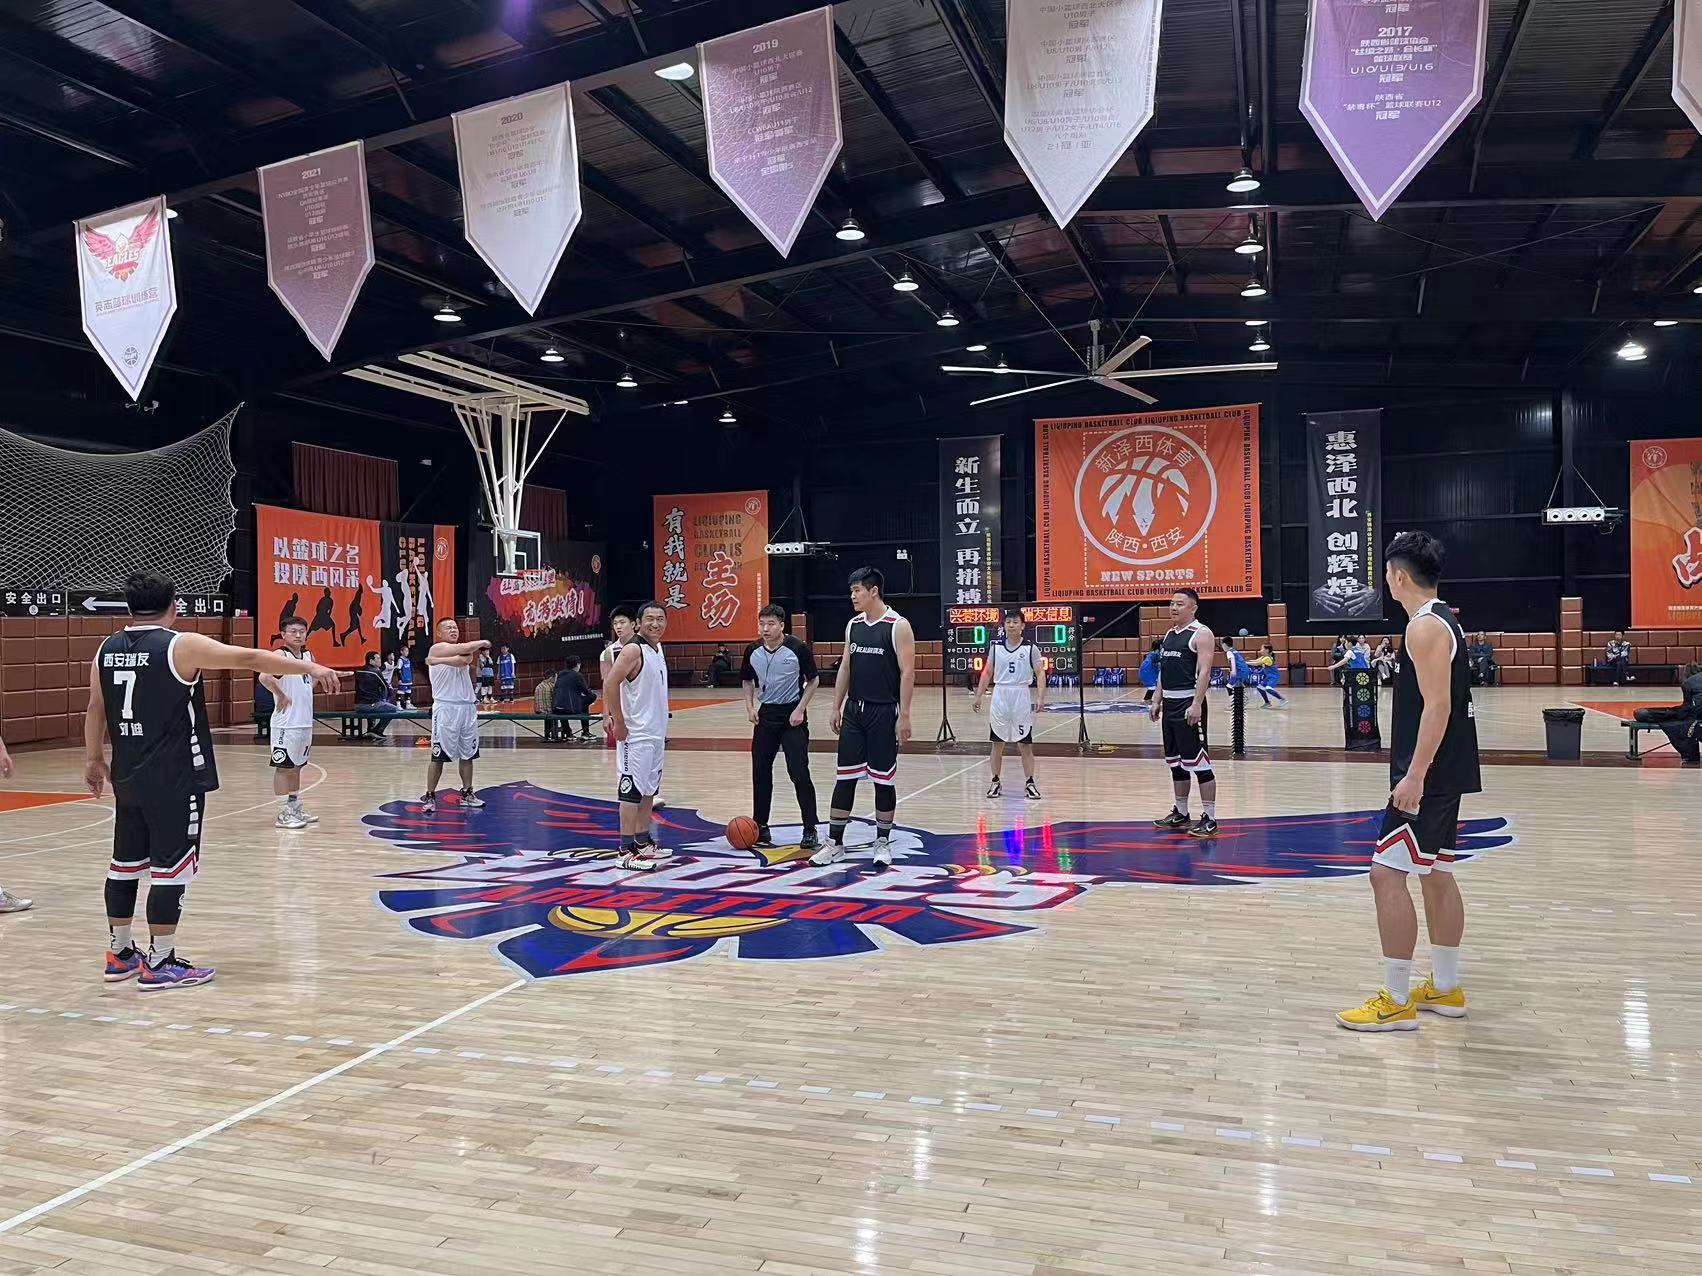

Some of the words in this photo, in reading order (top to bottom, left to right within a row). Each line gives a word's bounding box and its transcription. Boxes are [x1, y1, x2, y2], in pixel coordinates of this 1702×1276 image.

[1378, 26, 1412, 37] 2017
[752, 39, 779, 53] 2019
[1378, 73, 1404, 83] 冠军
[500, 112, 524, 126] 2020
[1376, 110, 1400, 120] 冠军
[301, 168, 321, 180] 2021
[1084, 418, 1124, 428] BASKETBALL
[1125, 416, 1143, 426] CLUB
[1180, 412, 1222, 422] BASKETBALL
[1223, 409, 1242, 419] CLUB
[1094, 434, 1196, 473] 新泽西体育
[1325, 430, 1358, 518] 惠泽西北
[955, 456, 980, 536] 新生而立
[694, 514, 742, 526] LIQIUPING
[694, 529, 742, 539] BASKETBALL
[273, 536, 360, 565] 以篮球之名
[663, 507, 688, 609] 有我就是
[1326, 531, 1359, 596] 创辉煌
[273, 561, 360, 588] 投陕西风采
[956, 547, 981, 605] 再拼搏
[1101, 569, 1134, 582] NEW
[1136, 568, 1195, 581] SPORTS
[701, 550, 740, 628] 主场
[1085, 587, 1126, 597] BASKETBALL
[1127, 586, 1145, 596] CLUB
[1225, 584, 1244, 594] CLUB
[5, 591, 62, 605] 安全出口
[175, 598, 224, 613] 全出口
[974, 626, 986, 645] 0
[1055, 625, 1067, 644] 0
[103, 652, 150, 667] 西安瑞友
[973, 657, 983, 671] 0
[1009, 662, 1016, 673] 5
[113, 671, 137, 719] 7
[119, 722, 144, 737] 刘迪
[1019, 725, 1025, 735] 5
